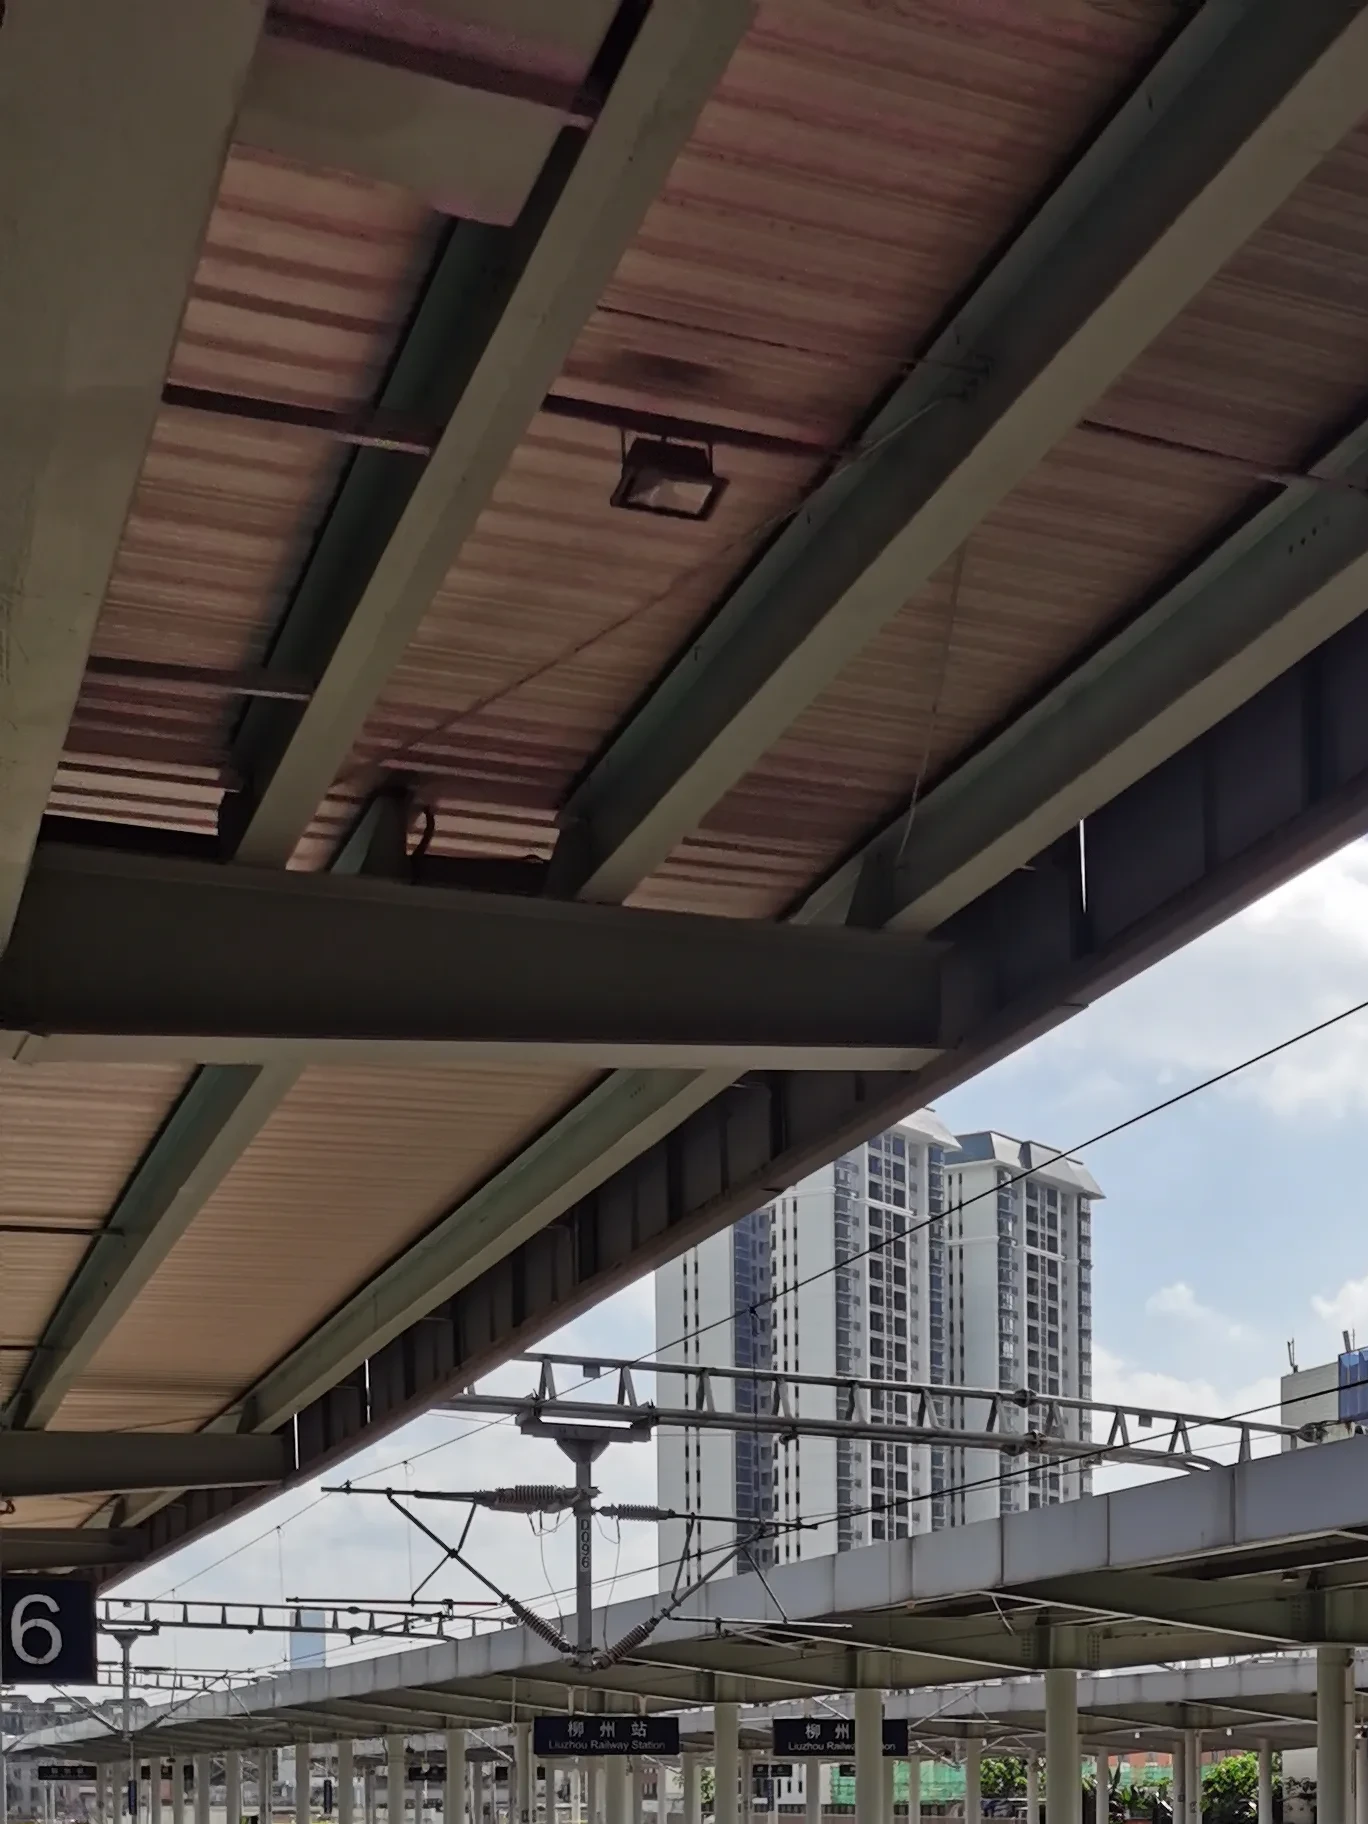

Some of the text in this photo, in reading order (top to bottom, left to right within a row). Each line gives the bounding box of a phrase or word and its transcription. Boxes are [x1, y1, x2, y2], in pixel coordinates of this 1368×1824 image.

[10, 1593, 63, 1665] 6
[567, 1720, 648, 1738] 柳州站
[548, 1740, 666, 1751] Liuzhou Railway Station
[788, 1741, 824, 1751] Liuzhou
